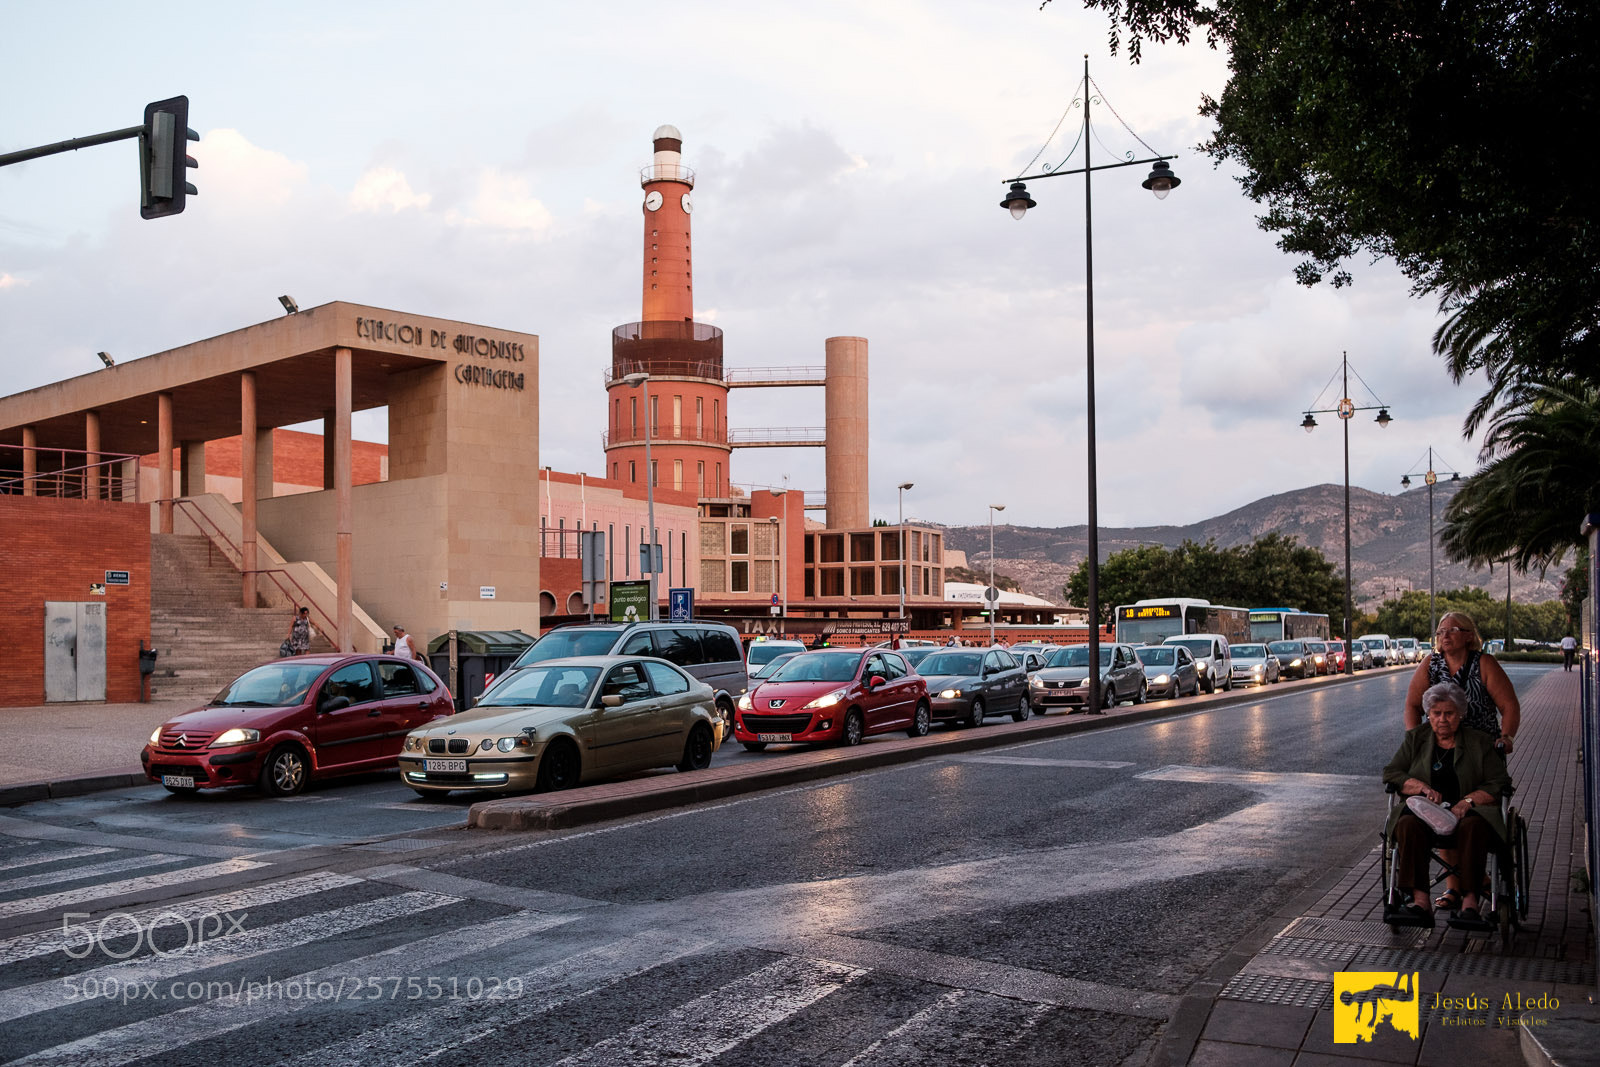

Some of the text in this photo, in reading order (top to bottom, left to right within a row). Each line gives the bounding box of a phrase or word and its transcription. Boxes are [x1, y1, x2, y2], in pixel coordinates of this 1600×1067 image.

[356, 316, 525, 361] ESTACION DE AUTOBUSES
[455, 363, 525, 390] CARTAGENA
[677, 594, 683, 604] P
[742, 619, 785, 634] TAXI
[428, 761, 465, 771] 1285 BPG
